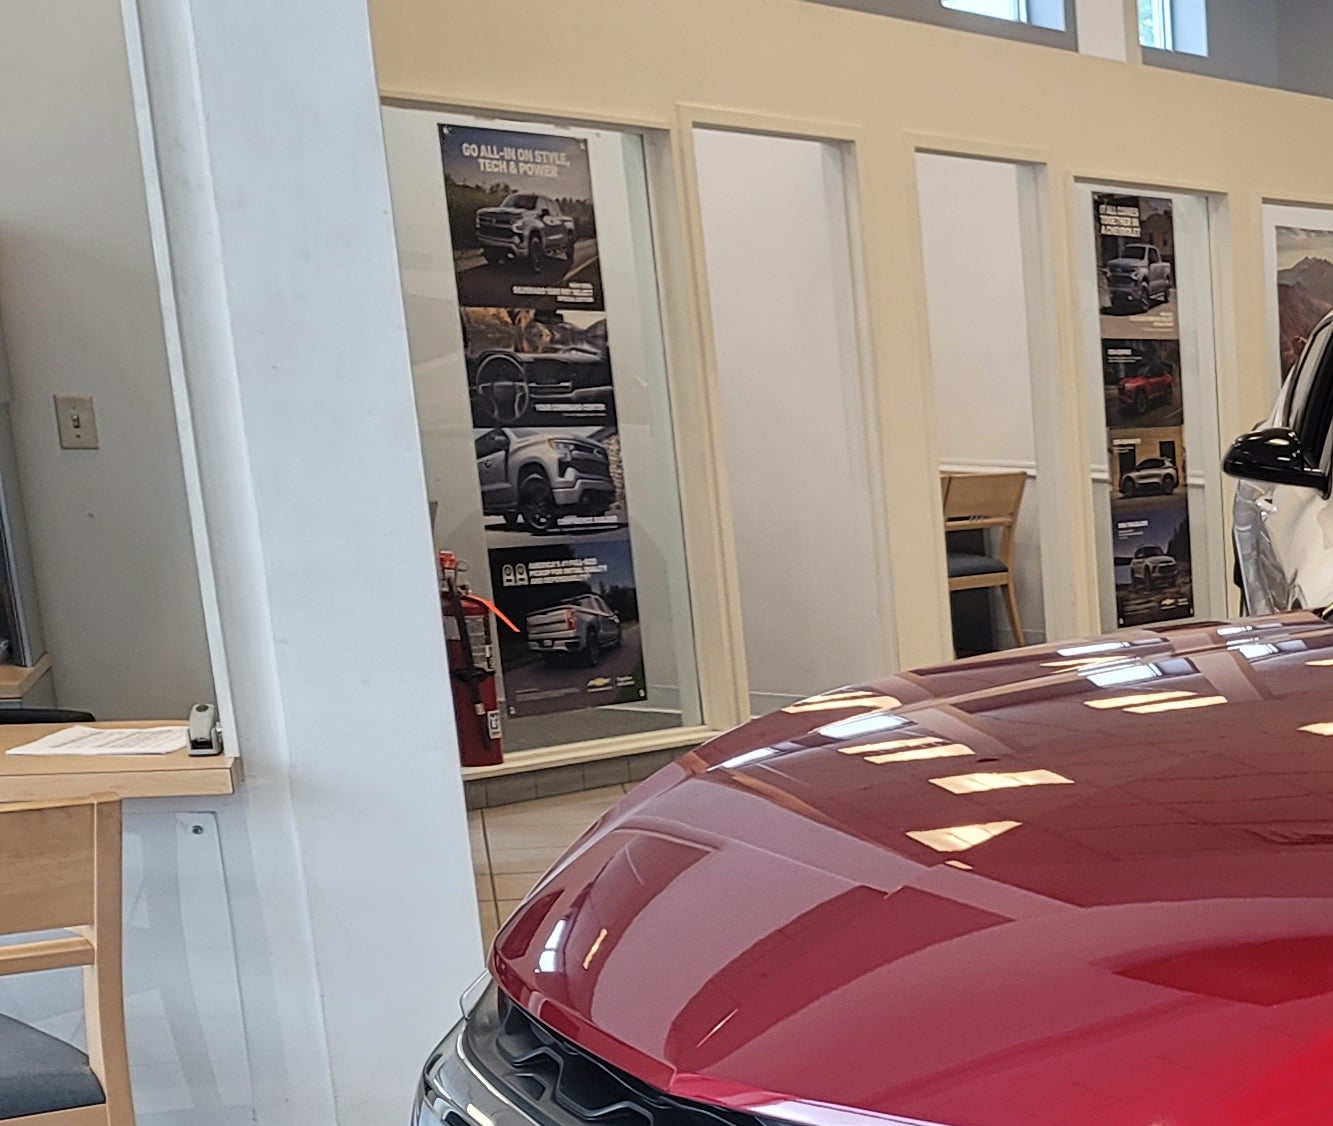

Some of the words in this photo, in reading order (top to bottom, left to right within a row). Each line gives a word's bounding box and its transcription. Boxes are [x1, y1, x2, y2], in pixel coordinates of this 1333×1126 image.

[462, 143, 478, 157] GO
[517, 148, 533, 161] ON
[478, 158, 507, 173] TECH
[508, 161, 518, 174] &
[518, 162, 560, 178] POWER
